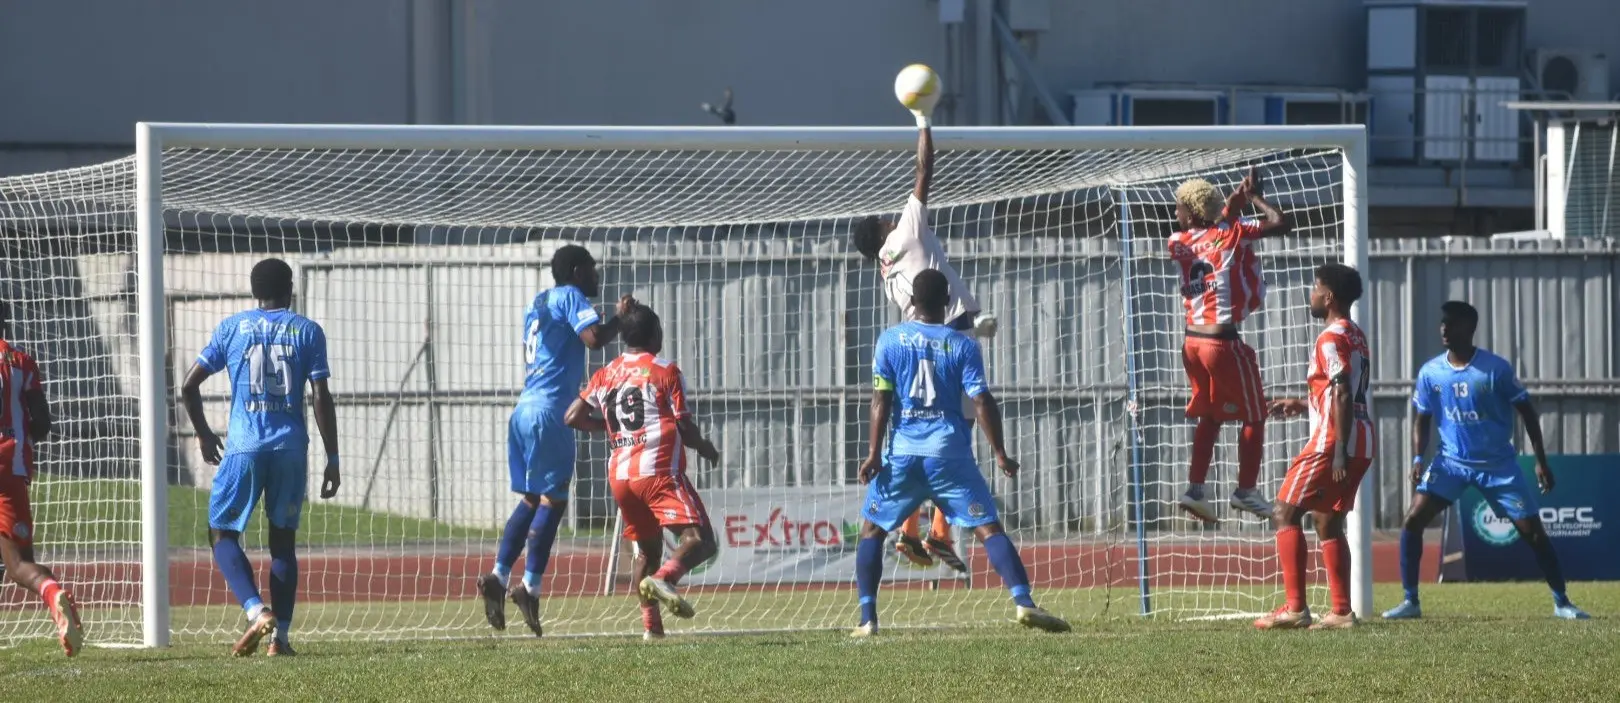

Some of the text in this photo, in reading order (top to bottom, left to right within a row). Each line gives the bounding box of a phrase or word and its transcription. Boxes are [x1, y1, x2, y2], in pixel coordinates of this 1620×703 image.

[245, 344, 293, 395] 15
[909, 359, 936, 407] 4
[603, 386, 645, 433] 19
[1452, 382, 1468, 398] 13
[724, 507, 841, 547] Extra
[1539, 507, 1593, 522] OFC
[1553, 522, 1602, 530] DEVELOPMENT
